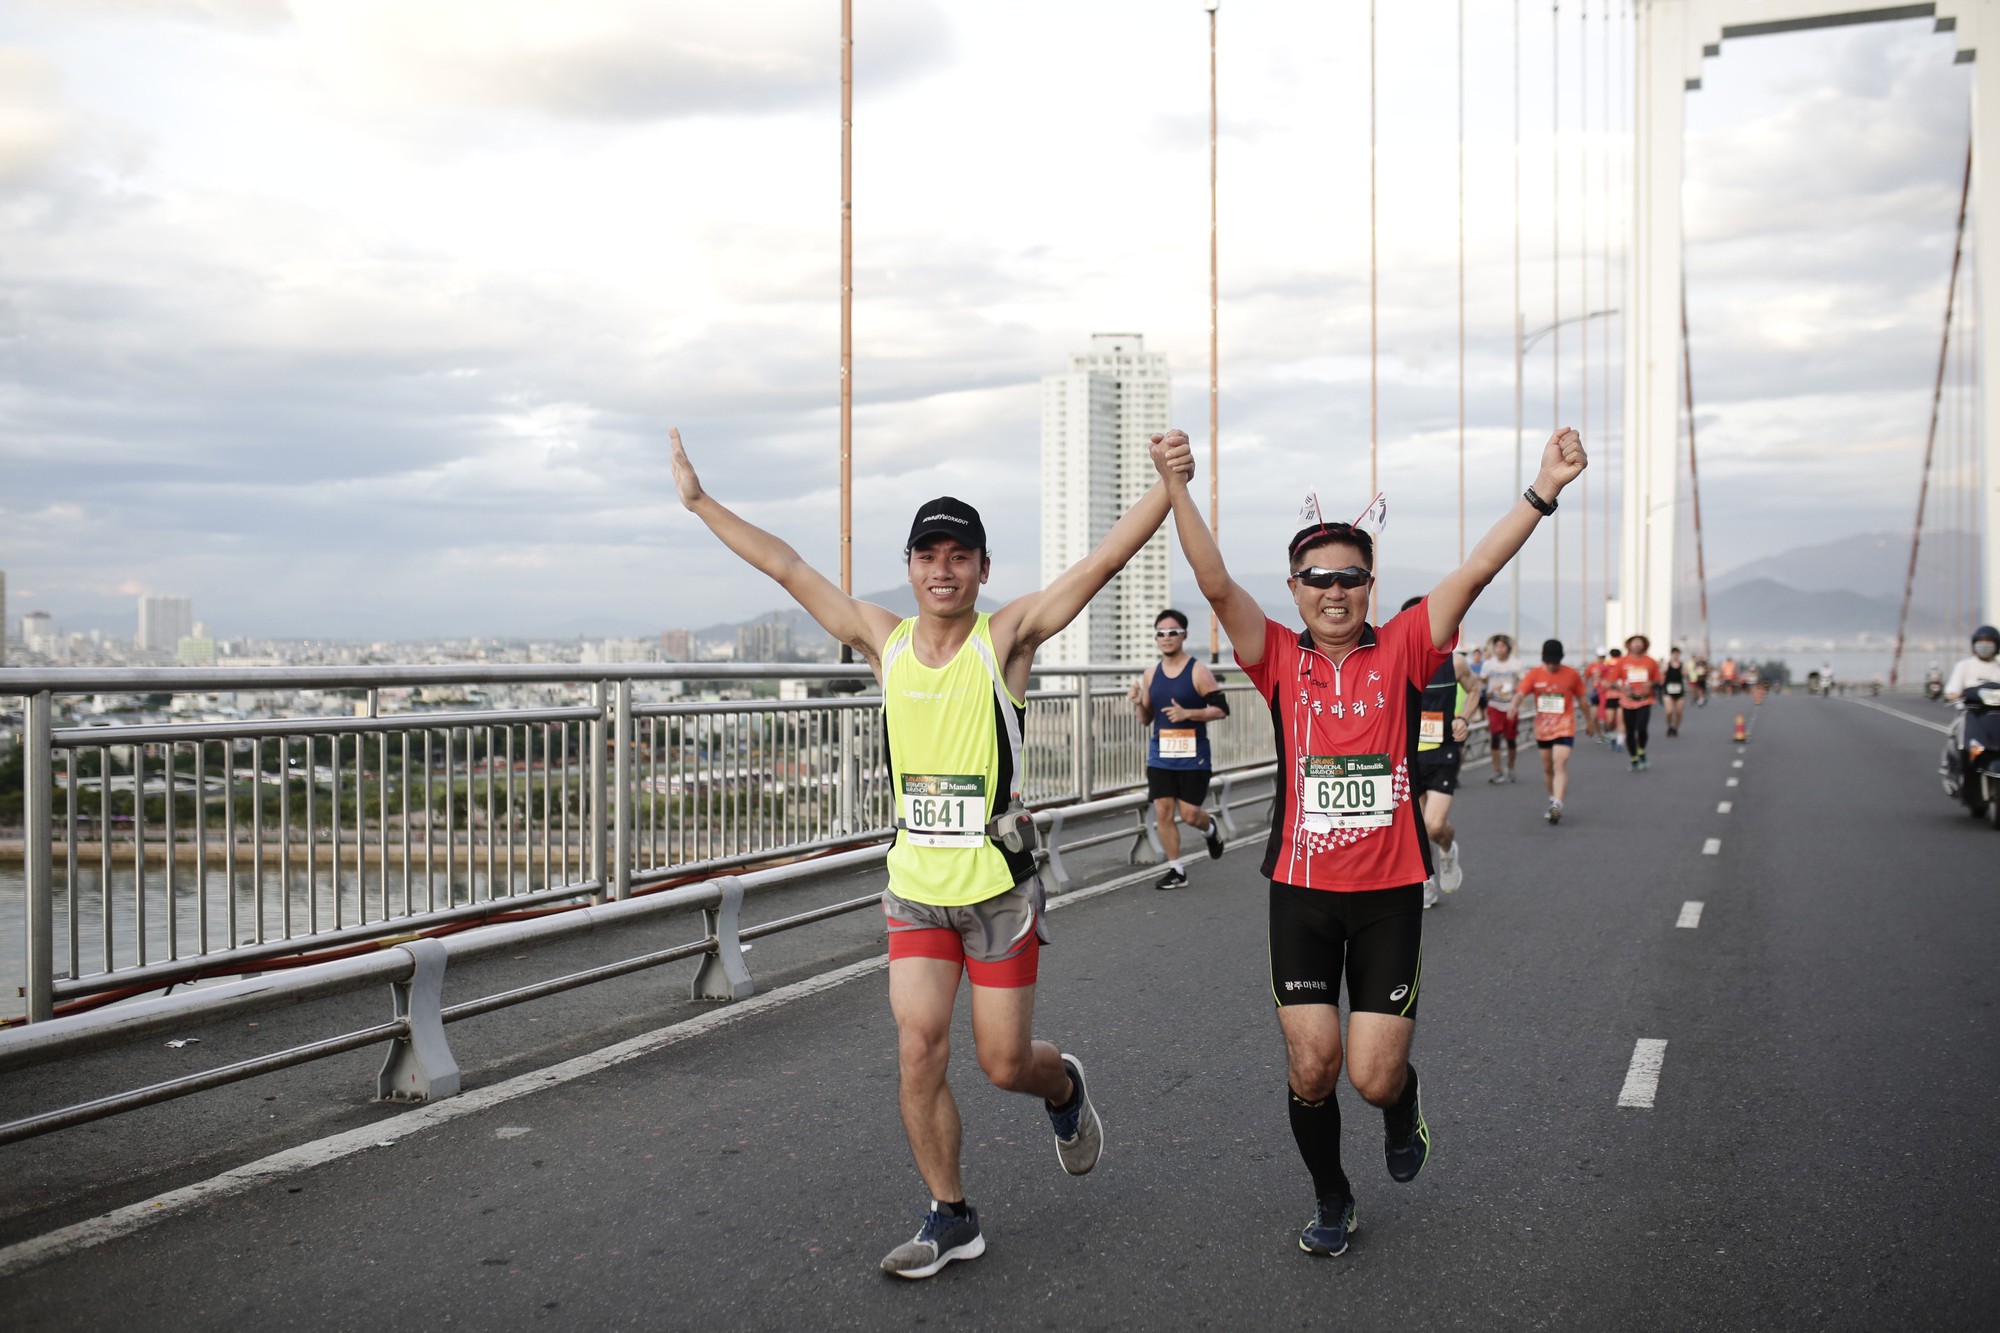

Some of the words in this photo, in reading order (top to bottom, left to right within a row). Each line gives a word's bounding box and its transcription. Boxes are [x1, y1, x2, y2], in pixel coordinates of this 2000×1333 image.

[1356, 763, 1384, 771] Manulife
[948, 783, 978, 791] Manulife
[1317, 779, 1376, 809] 6209
[913, 799, 966, 828] 6641
[1284, 980, 1328, 991] 광주마라톤
